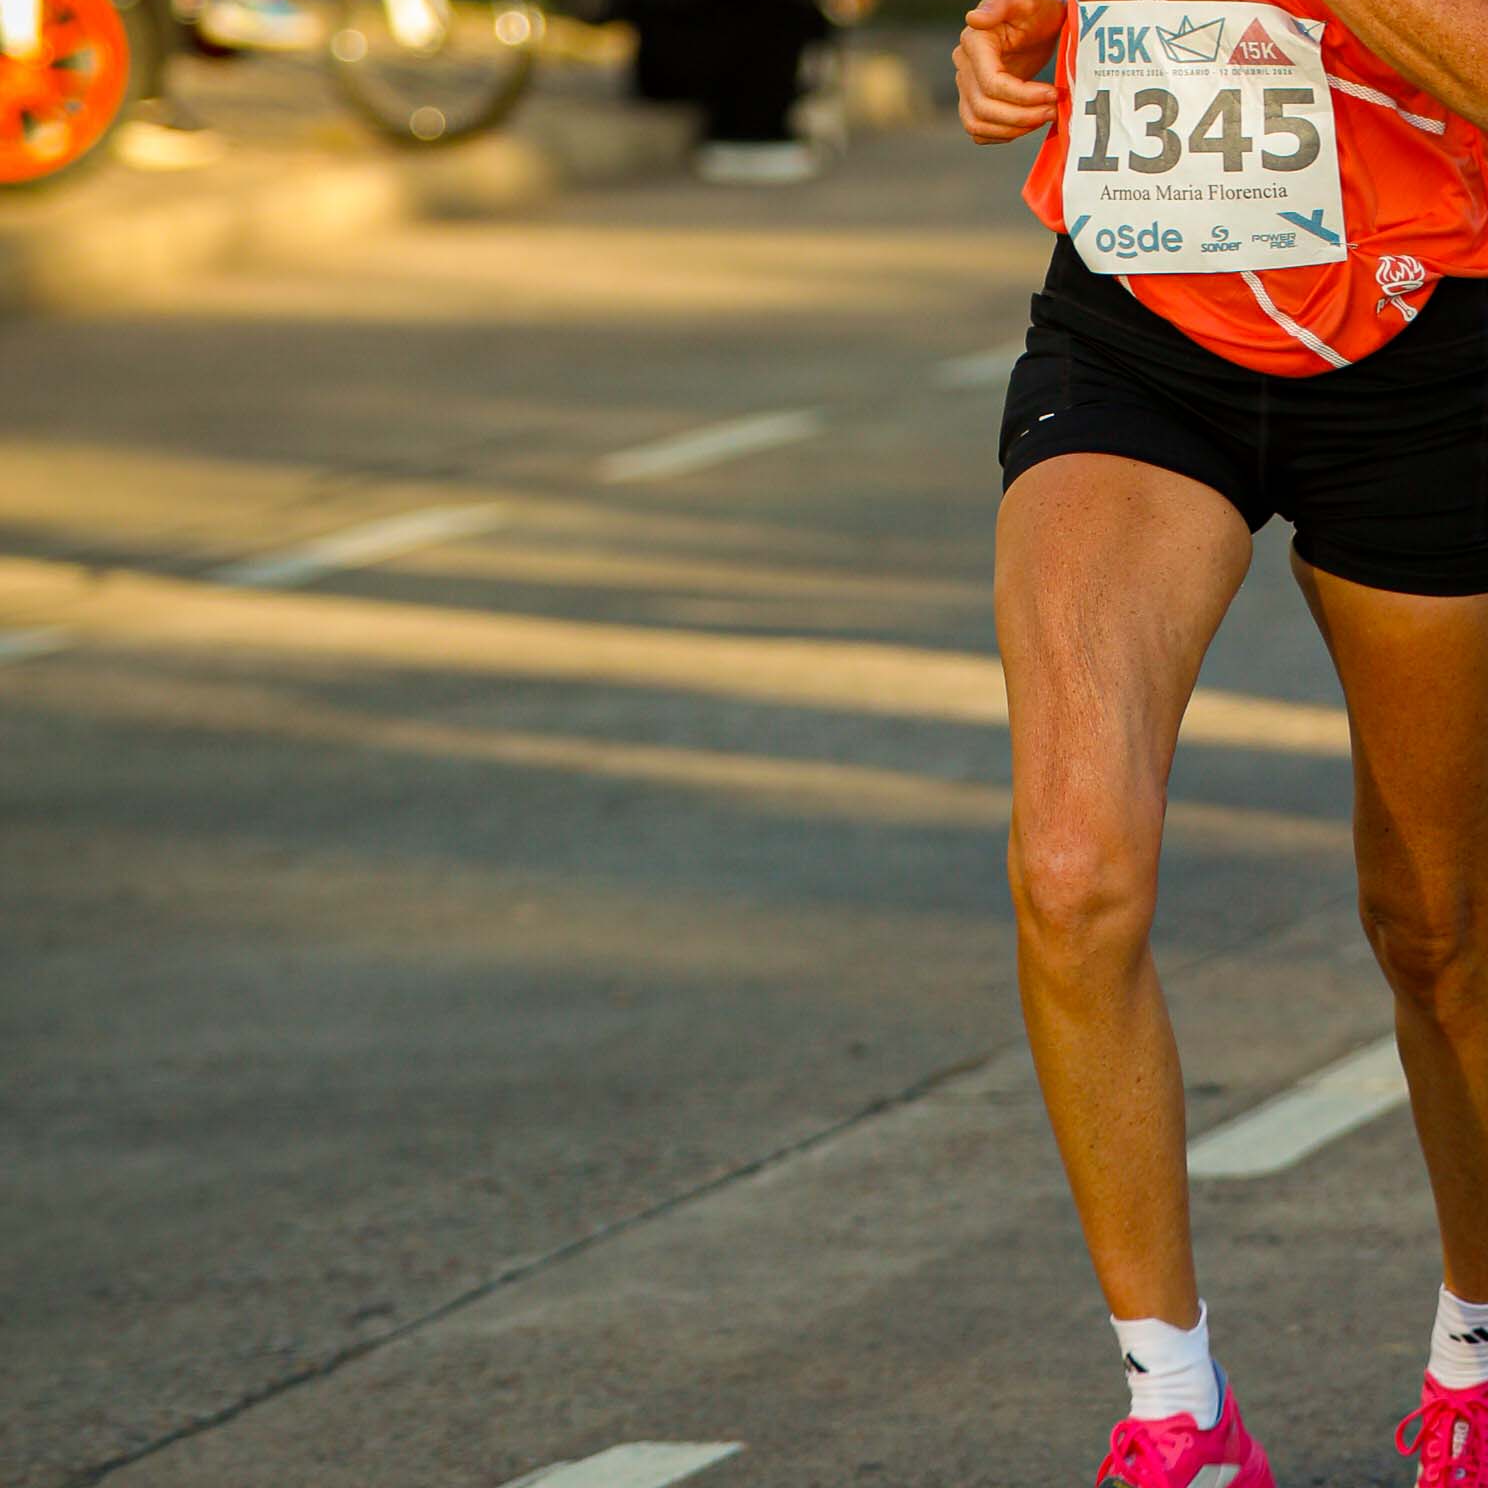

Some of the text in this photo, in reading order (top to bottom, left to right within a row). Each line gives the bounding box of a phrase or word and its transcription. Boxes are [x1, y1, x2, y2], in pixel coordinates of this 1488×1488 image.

[1095, 26, 1152, 64] 15K
[1239, 41, 1278, 61] 15K
[1077, 88, 1321, 174] 1345
[1100, 182, 1289, 201] Armoa Maria Florencia
[1096, 220, 1183, 254] osde
[1251, 232, 1297, 242] POWER
